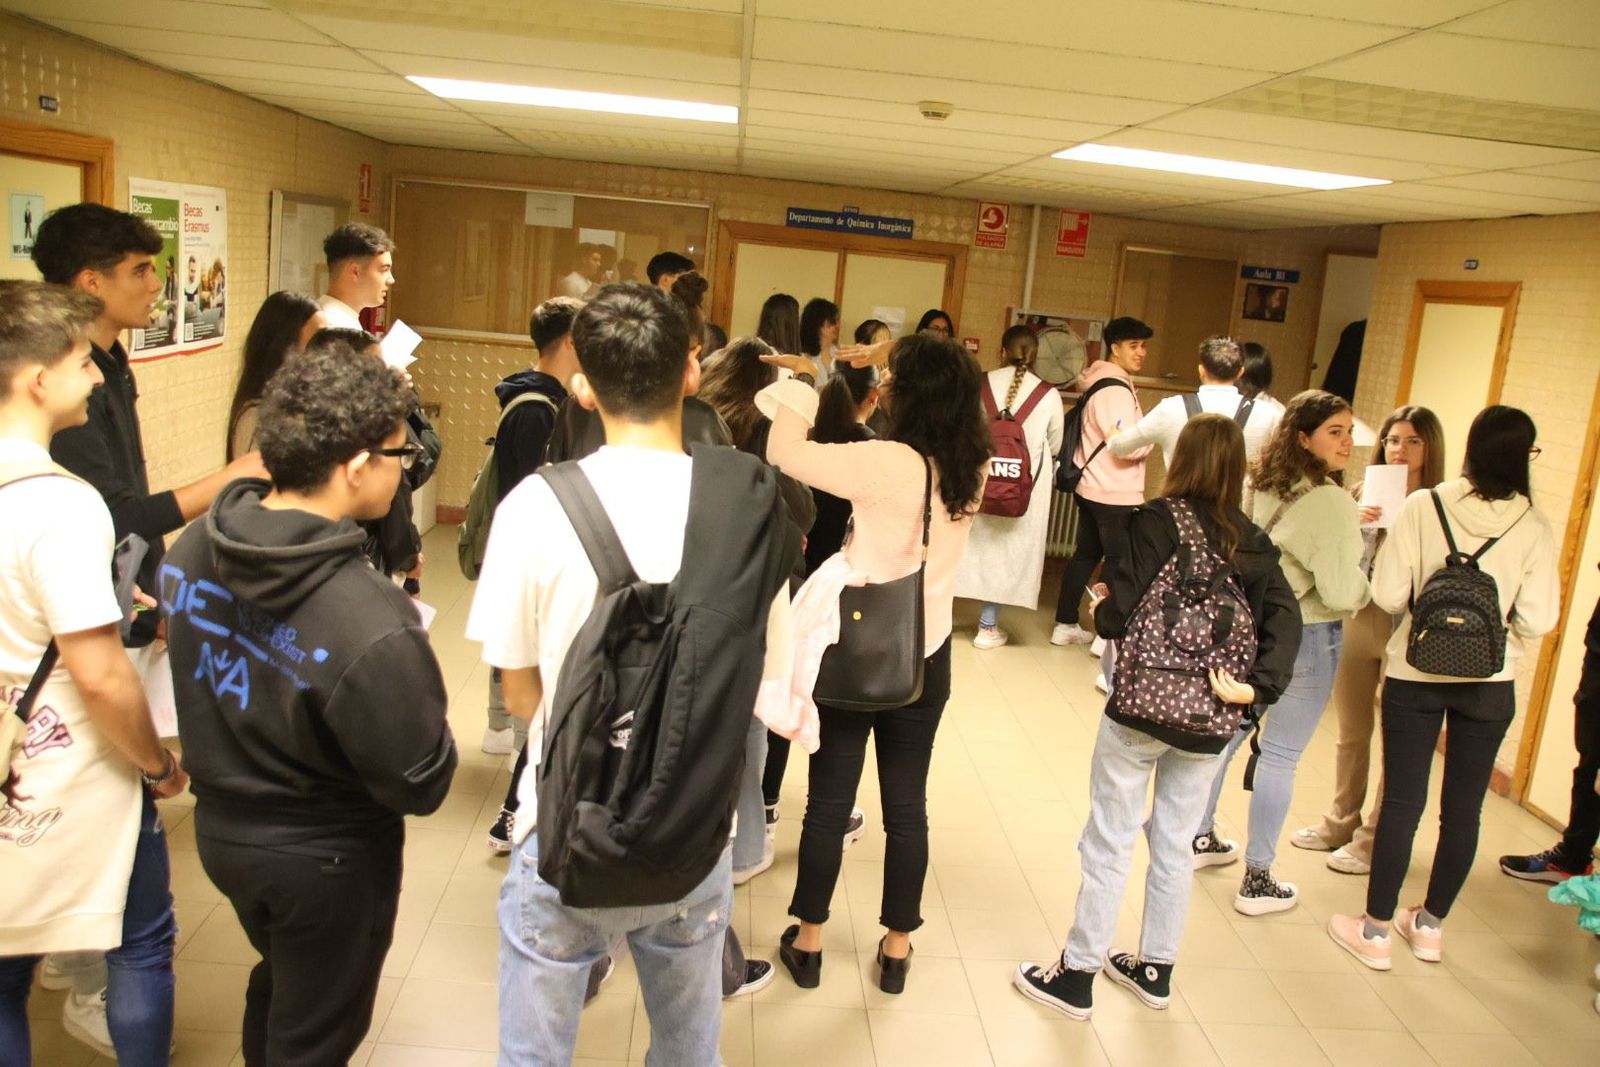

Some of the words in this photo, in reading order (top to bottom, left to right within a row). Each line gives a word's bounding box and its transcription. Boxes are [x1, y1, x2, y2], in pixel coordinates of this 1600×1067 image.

[133, 198, 153, 214] Becas
[184, 203, 203, 218] Becas
[184, 219, 210, 233] Erasmus
[789, 211, 834, 225] Departamento
[836, 217, 844, 226] de
[1253, 268, 1273, 280] Aula
